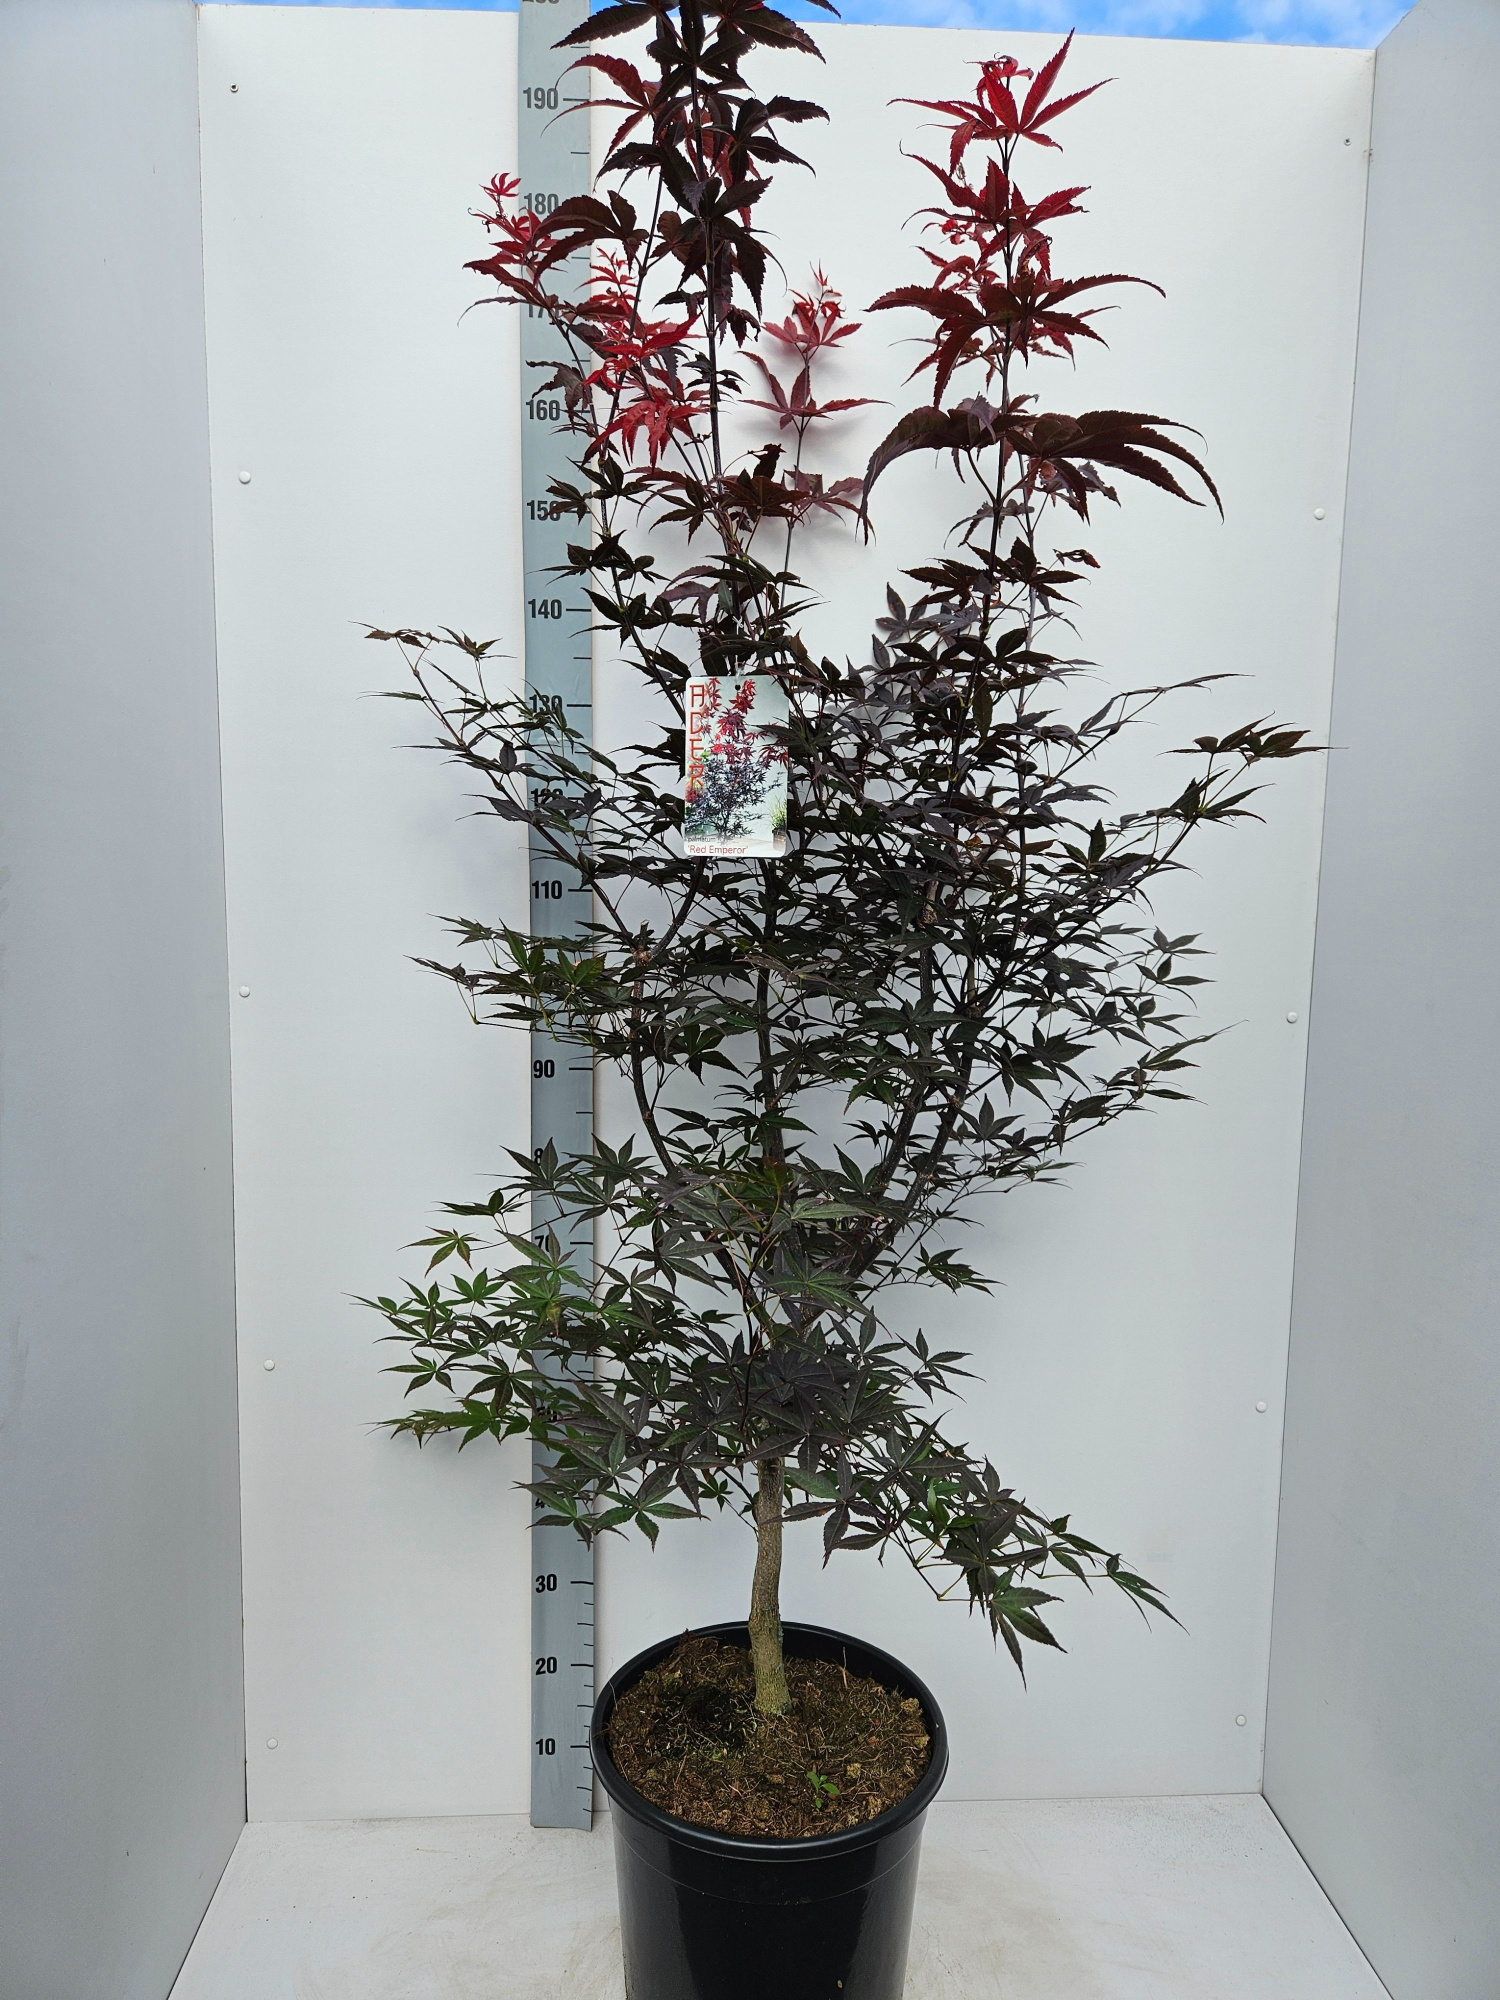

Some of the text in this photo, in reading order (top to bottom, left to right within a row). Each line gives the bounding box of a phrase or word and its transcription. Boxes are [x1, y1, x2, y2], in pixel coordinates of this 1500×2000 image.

[522, 87, 559, 110] 190
[523, 192, 559, 216] 180
[525, 399, 561, 421] 160
[526, 499, 561, 521] 150
[527, 598, 563, 620] 140
[531, 879, 563, 900] 110
[533, 1059, 555, 1079] 90
[535, 1573, 558, 1594] 30
[535, 1656, 558, 1676] 20
[535, 1738, 556, 1756] 10
